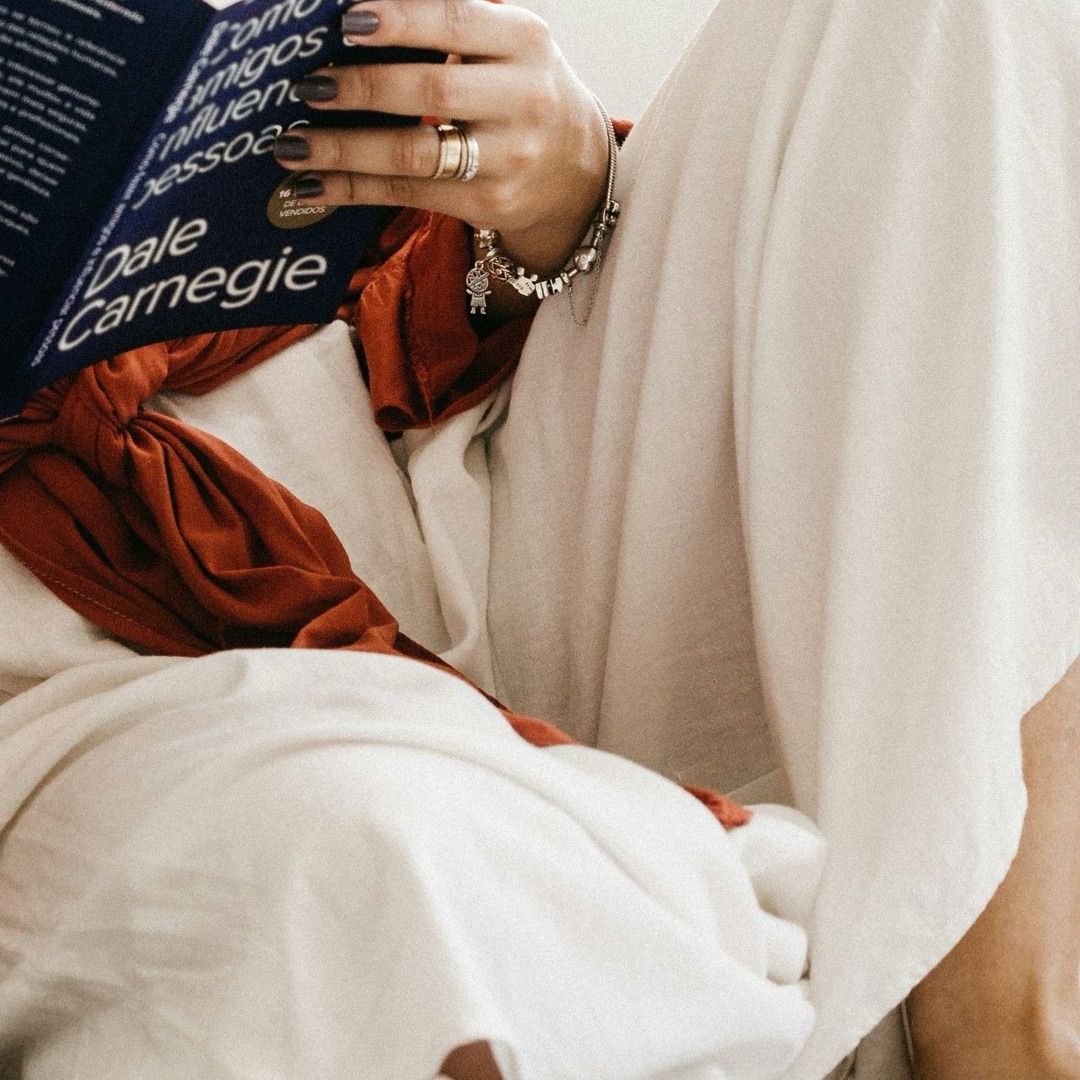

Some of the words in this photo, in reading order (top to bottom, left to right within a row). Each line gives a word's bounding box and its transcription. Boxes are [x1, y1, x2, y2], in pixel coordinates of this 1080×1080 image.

[279, 189, 291, 198] 16
[280, 206, 326, 217] VENDIDOS
[84, 217, 208, 300] Dale
[57, 246, 328, 351] Carnegie
